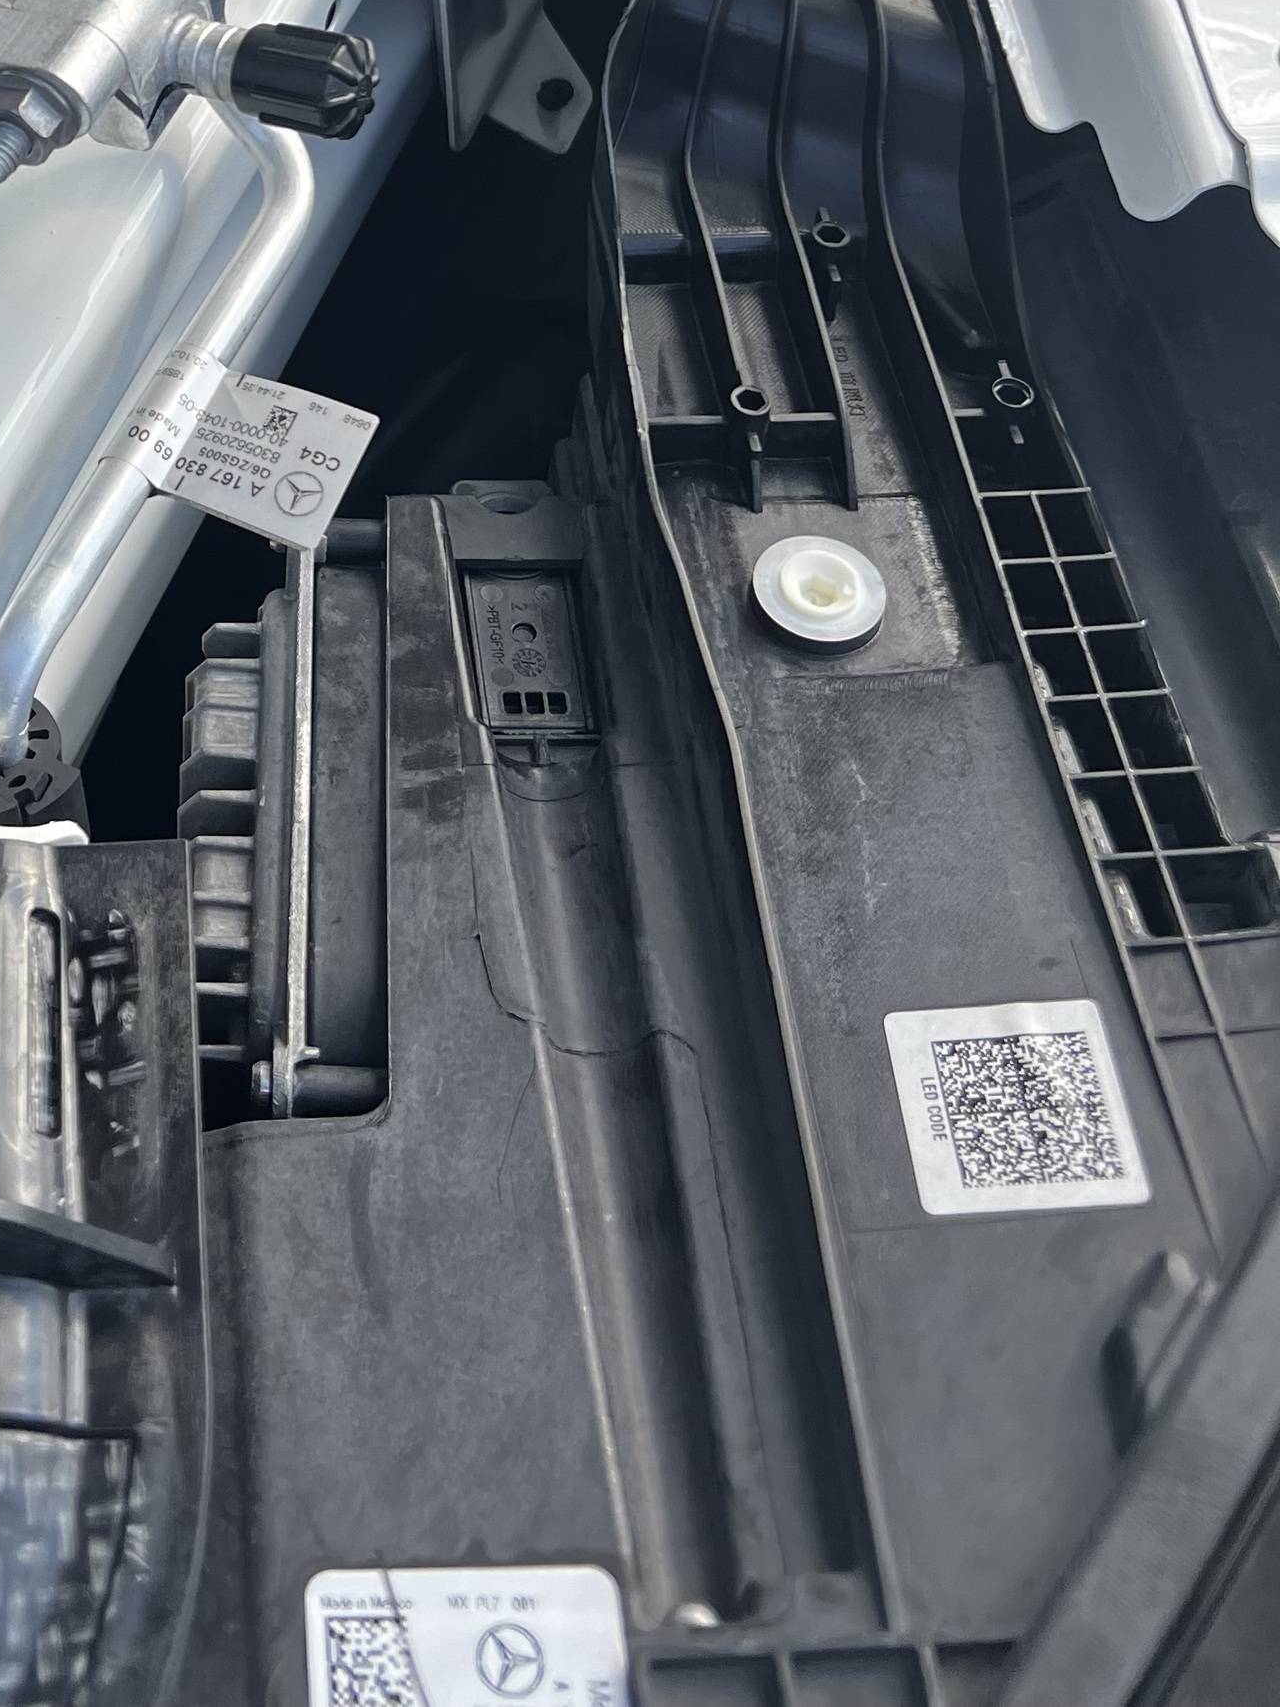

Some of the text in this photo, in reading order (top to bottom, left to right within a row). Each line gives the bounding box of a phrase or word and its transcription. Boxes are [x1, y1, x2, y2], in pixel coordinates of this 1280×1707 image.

[148, 409, 181, 438] Made
[128, 425, 266, 497] A 167 830 69 00
[195, 426, 281, 464] 8305620925
[199, 446, 271, 474] Q6/ZGS005
[300, 446, 340, 471] CG4
[920, 1077, 949, 1141] LED CODE
